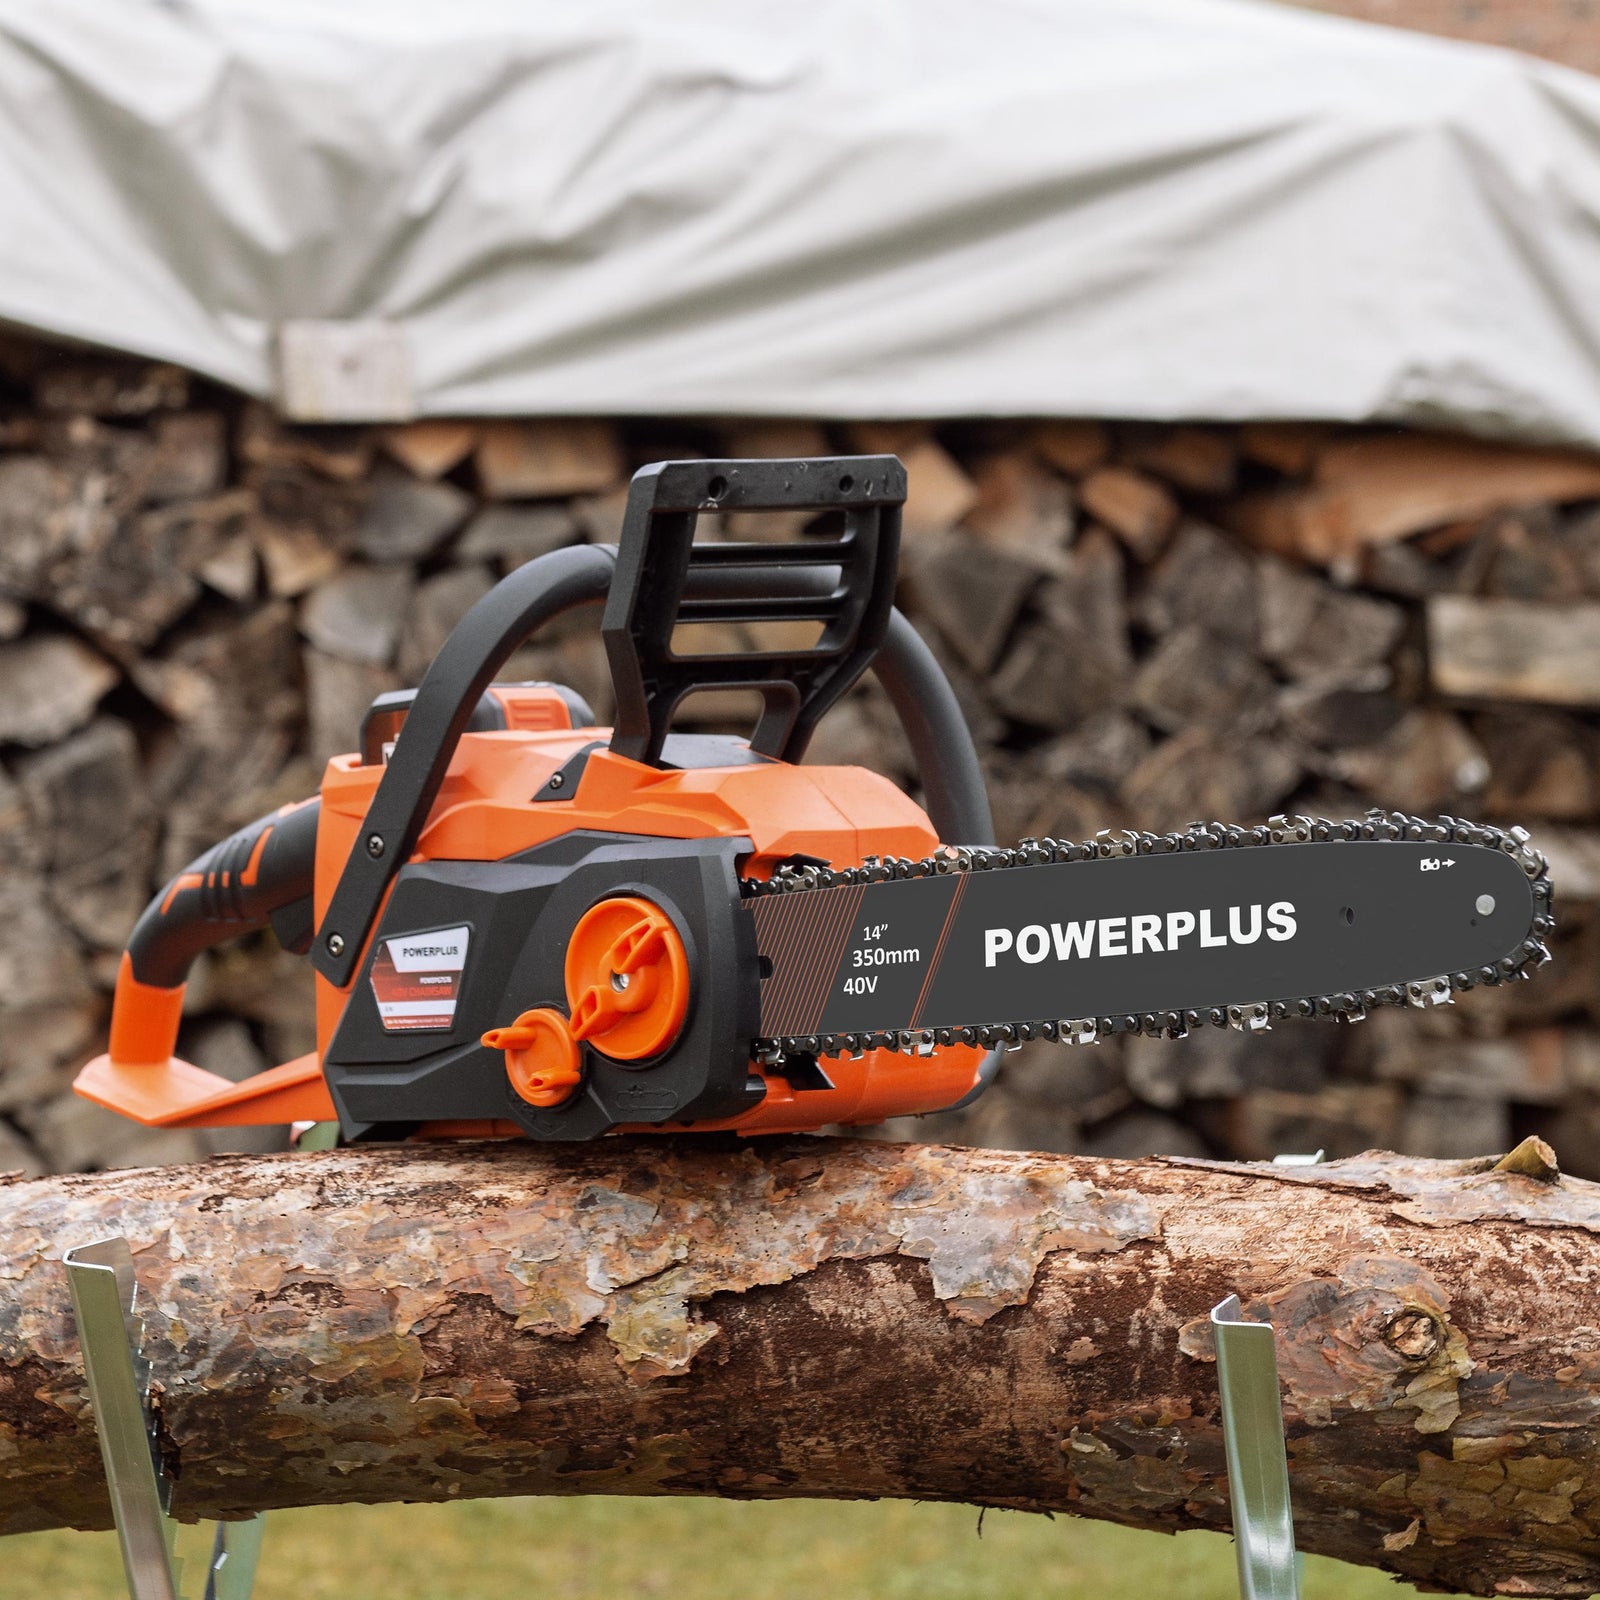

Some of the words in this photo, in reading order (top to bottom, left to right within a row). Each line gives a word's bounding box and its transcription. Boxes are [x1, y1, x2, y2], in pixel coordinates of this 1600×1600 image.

[985, 902, 1297, 968] POWERPLUS
[403, 946, 458, 957] POWERPLUS
[852, 947, 920, 968] 350mm
[843, 975, 879, 996] 40V
